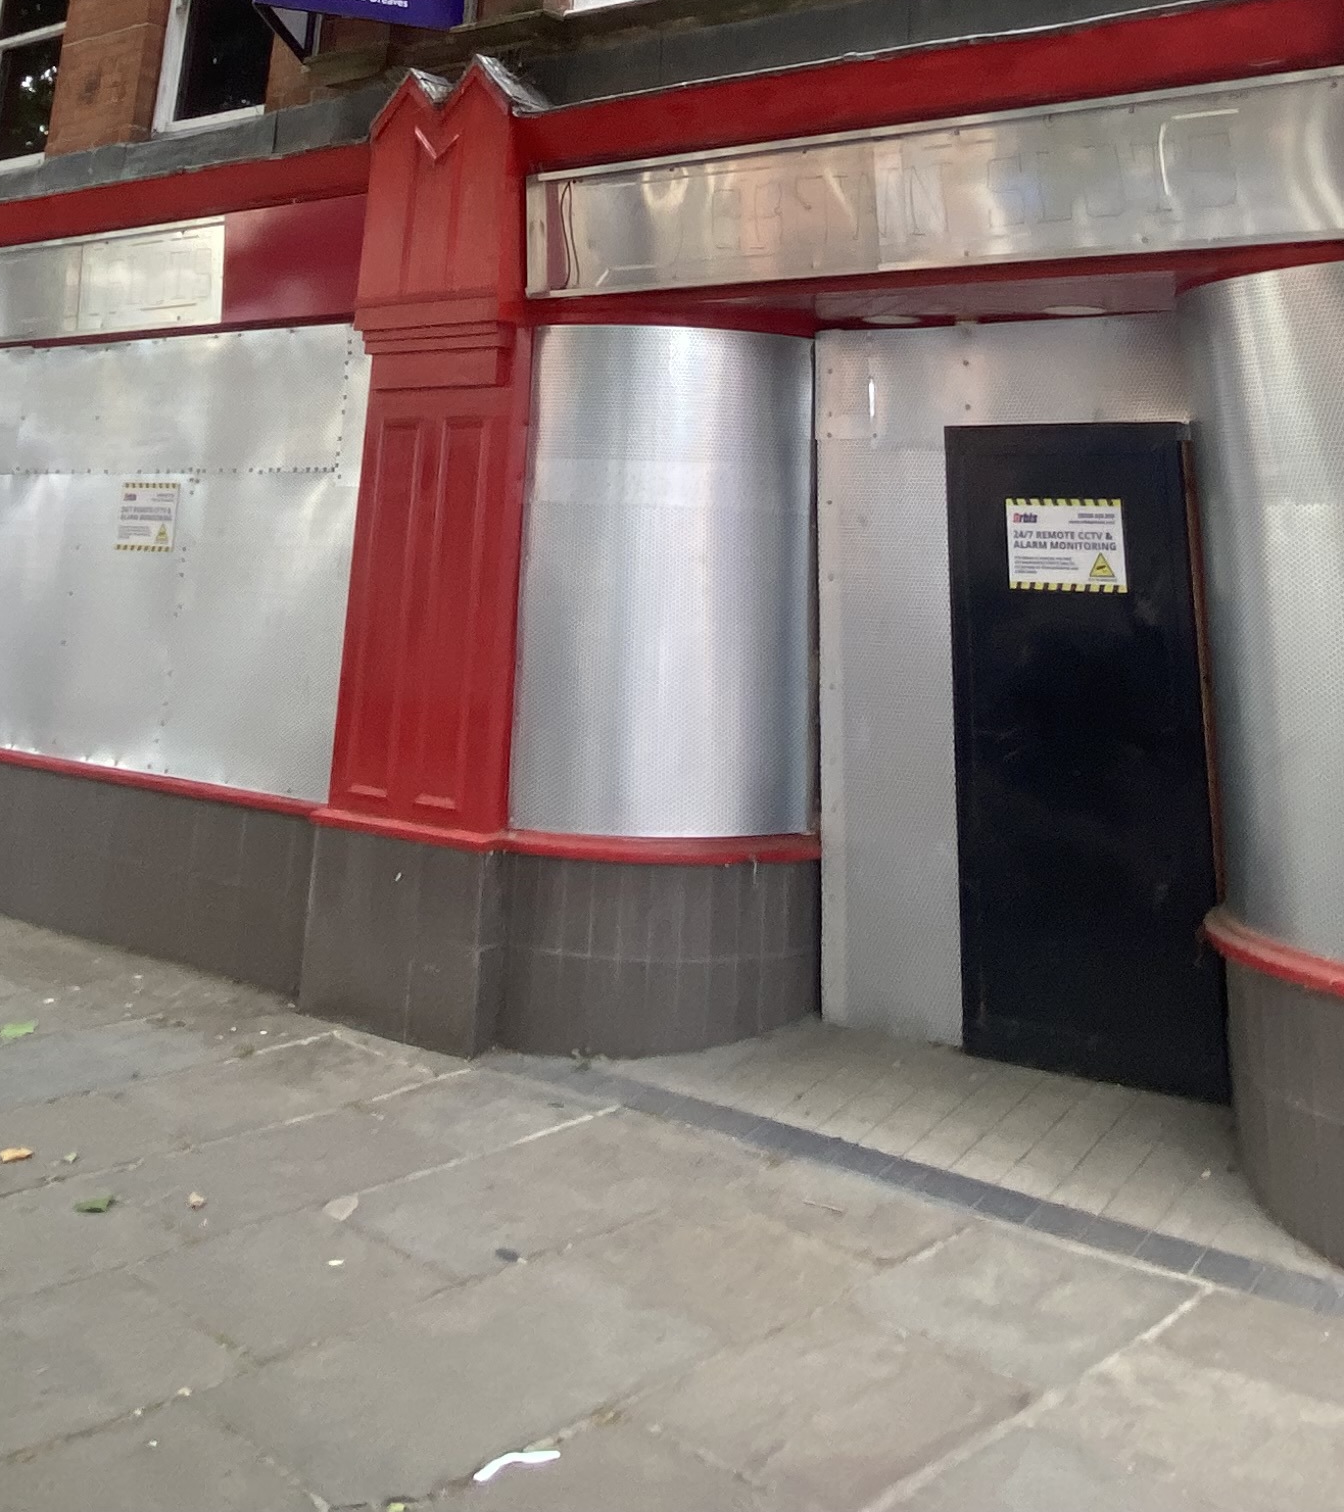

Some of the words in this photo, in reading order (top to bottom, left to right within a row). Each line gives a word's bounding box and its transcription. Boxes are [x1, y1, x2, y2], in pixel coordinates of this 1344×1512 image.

[1013, 530, 1034, 539] 24/7
[1036, 530, 1075, 540] REMOTE
[1078, 531, 1103, 540] CCTV
[1013, 540, 1048, 549] ALARM
[1050, 541, 1117, 551] MONITORING
